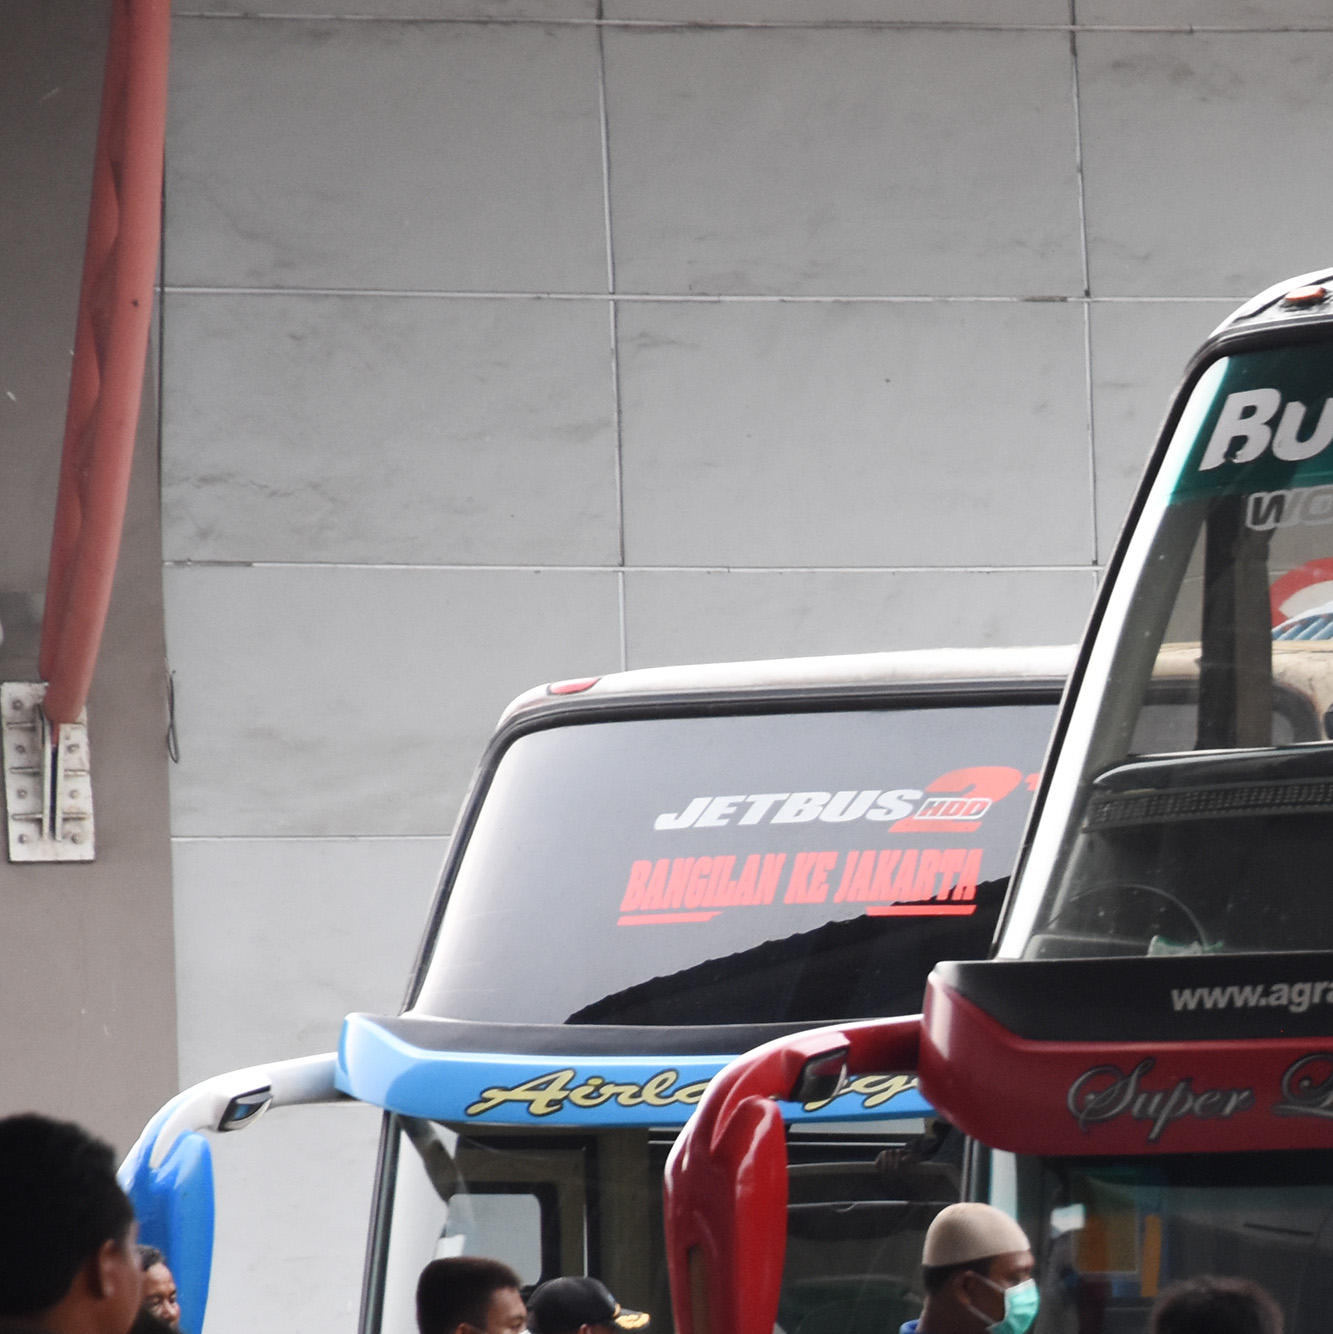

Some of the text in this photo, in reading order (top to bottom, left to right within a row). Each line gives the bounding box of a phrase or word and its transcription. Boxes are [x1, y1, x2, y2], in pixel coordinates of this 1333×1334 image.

[619, 847, 985, 913] BANGILAN KE JAKARTA
[1066, 1056, 1255, 1144] Super
